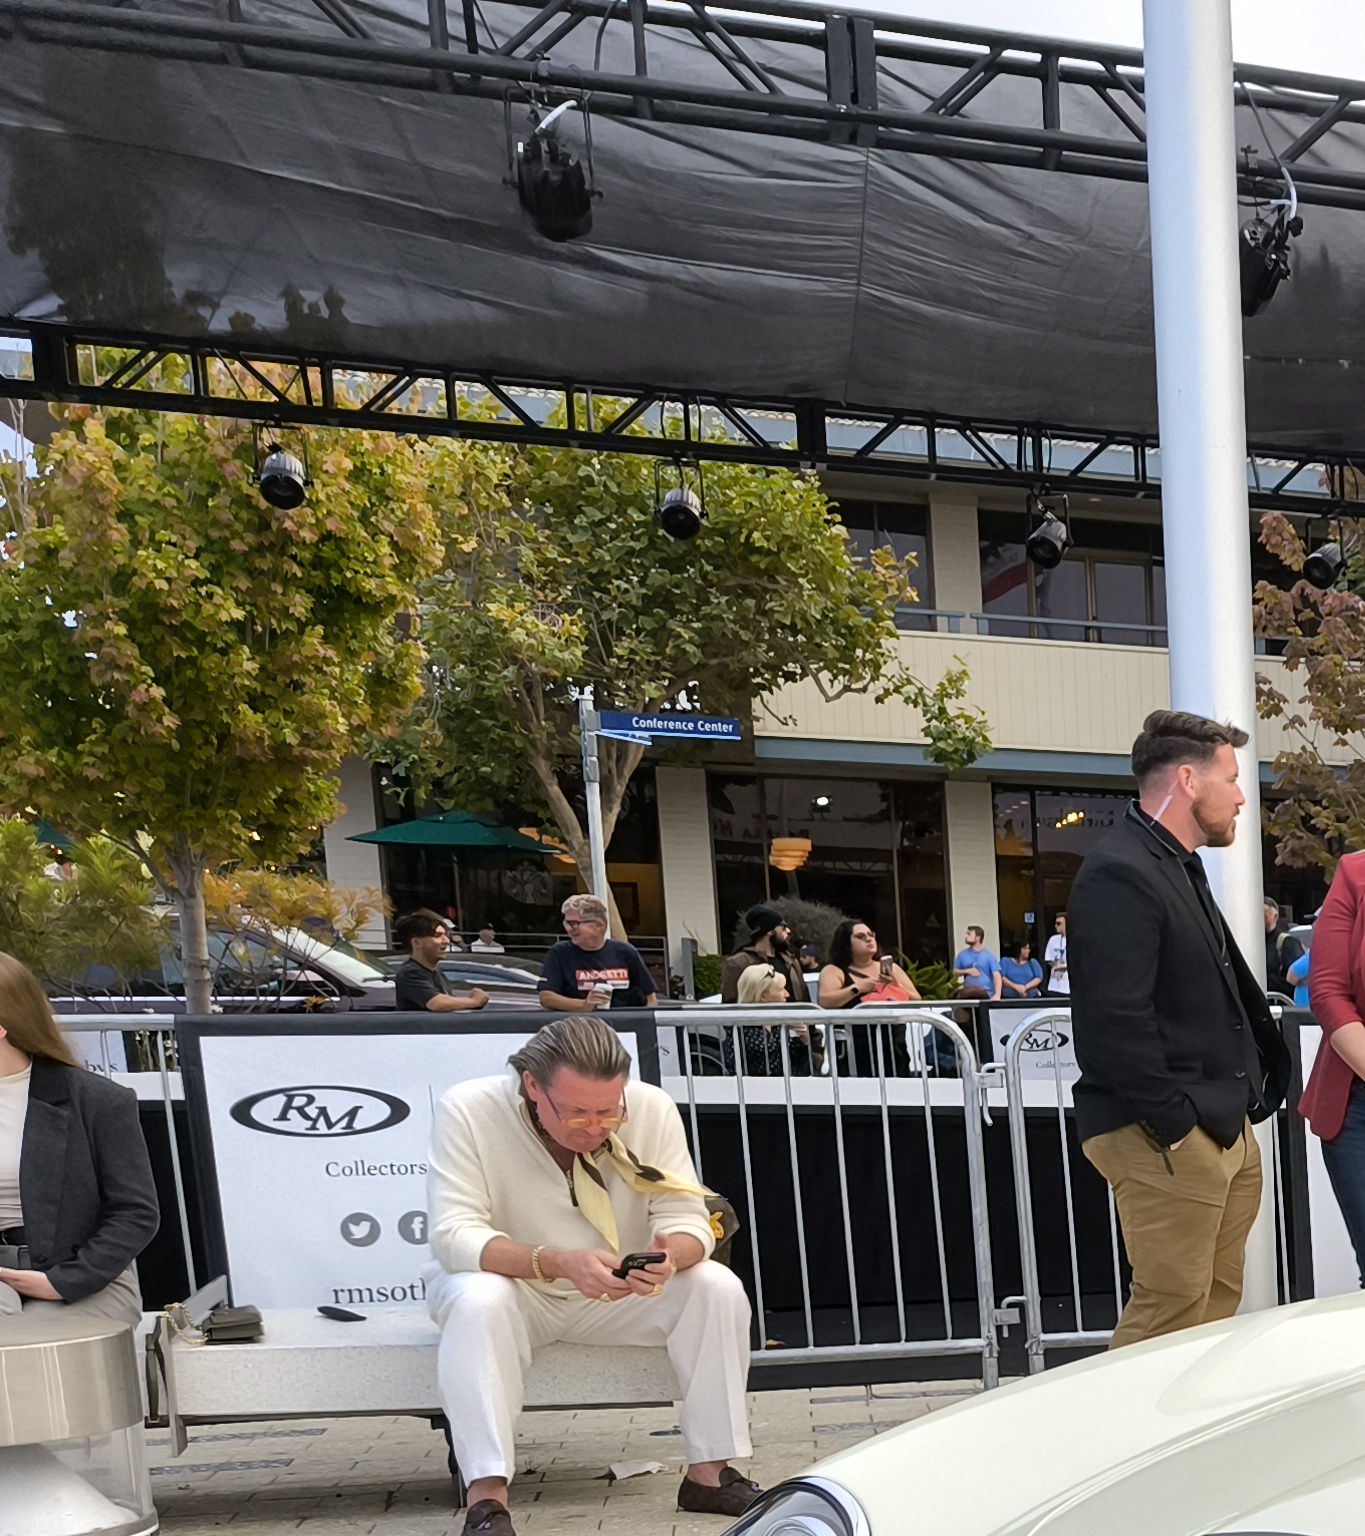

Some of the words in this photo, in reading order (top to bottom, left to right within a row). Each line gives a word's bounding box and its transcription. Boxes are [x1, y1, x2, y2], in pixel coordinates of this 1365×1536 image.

[631, 716, 695, 731] Conference
[697, 720, 734, 733] Center
[272, 1092, 364, 1131] RM
[325, 1159, 428, 1178] Collectors
